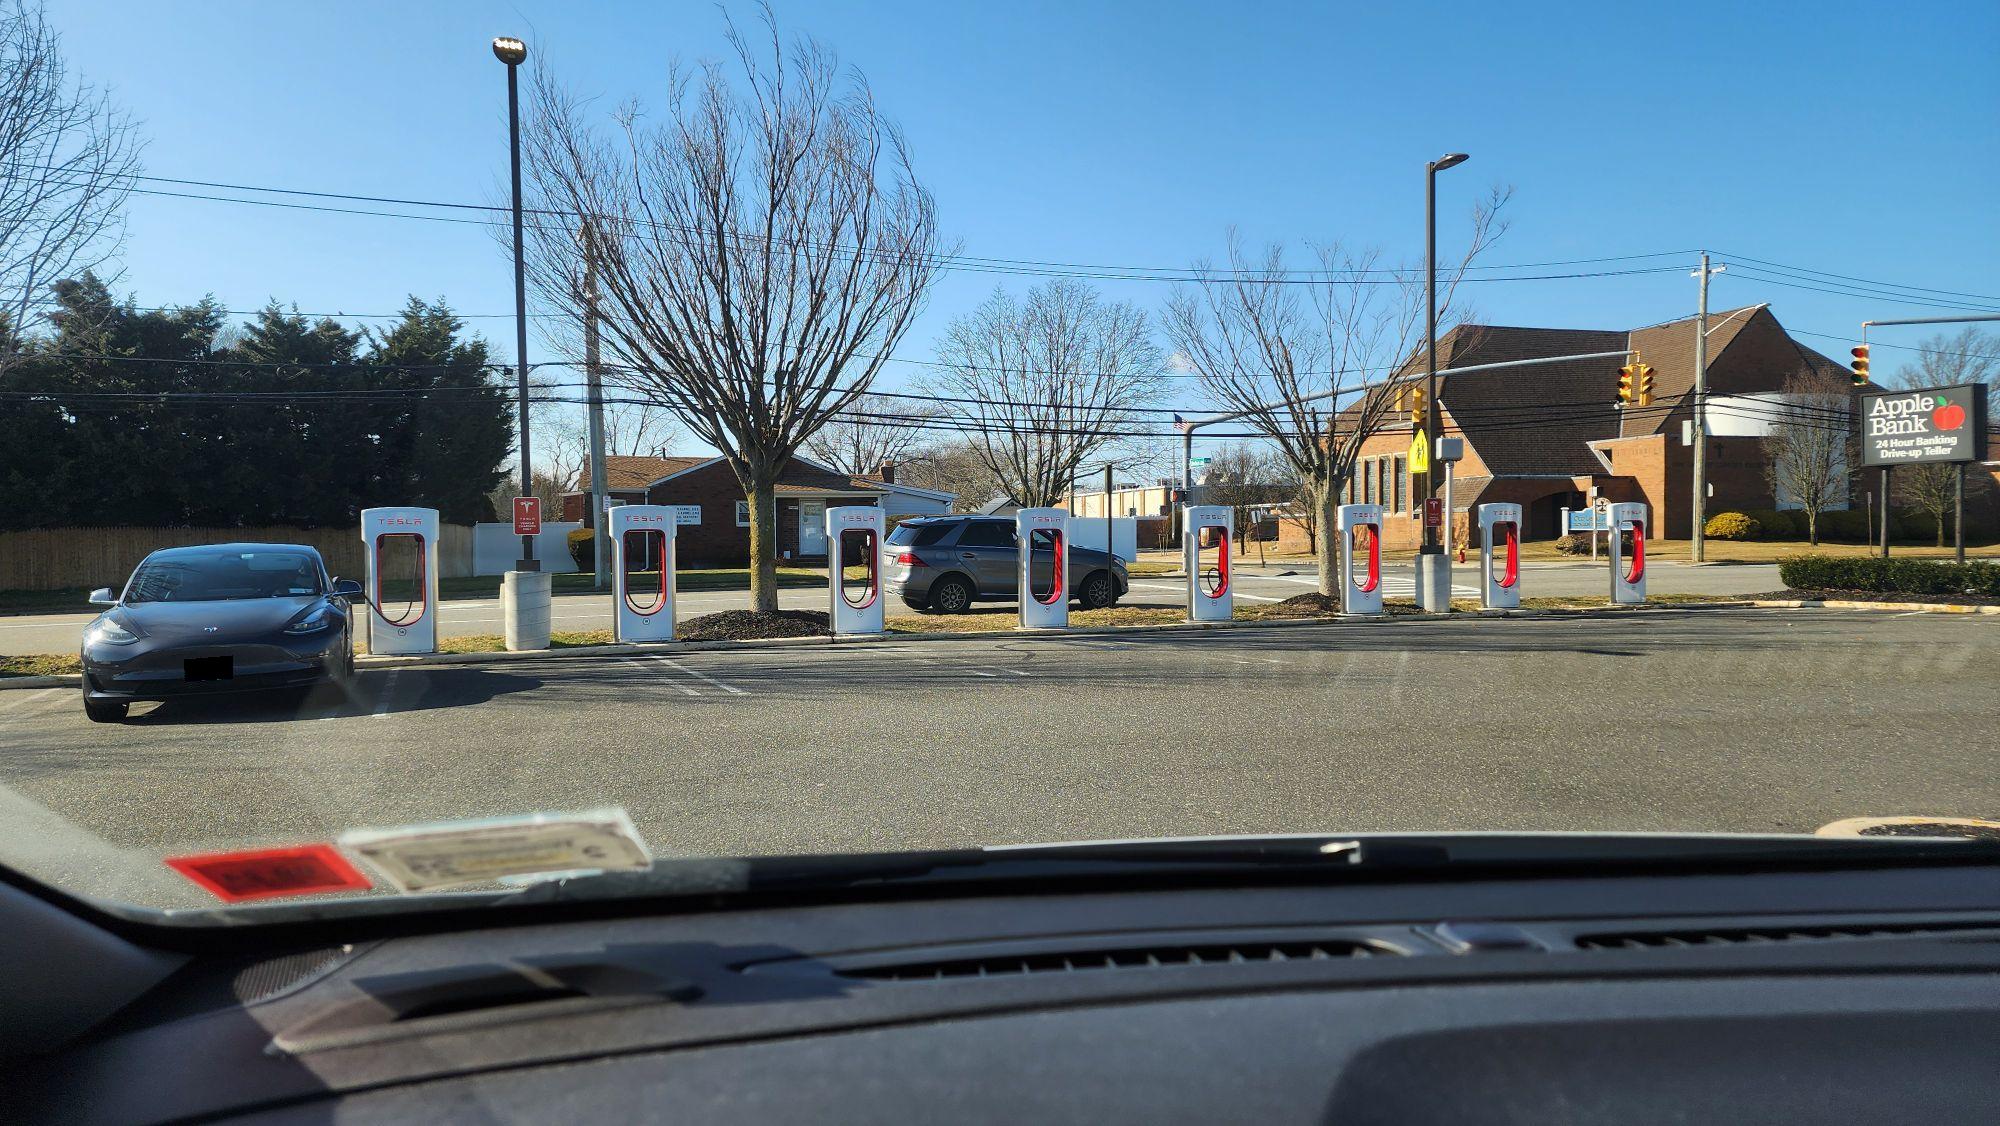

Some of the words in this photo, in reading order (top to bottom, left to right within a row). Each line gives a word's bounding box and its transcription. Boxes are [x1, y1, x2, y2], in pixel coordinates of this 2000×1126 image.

[1869, 394, 1934, 419] Apple
[1869, 415, 1929, 436] Bank
[1875, 440, 1889, 449] 24
[1890, 438, 1914, 448] Hour
[1916, 436, 1958, 446] Banking
[1880, 449, 1922, 459] Drive-up
[1924, 446, 1952, 456] Teller
